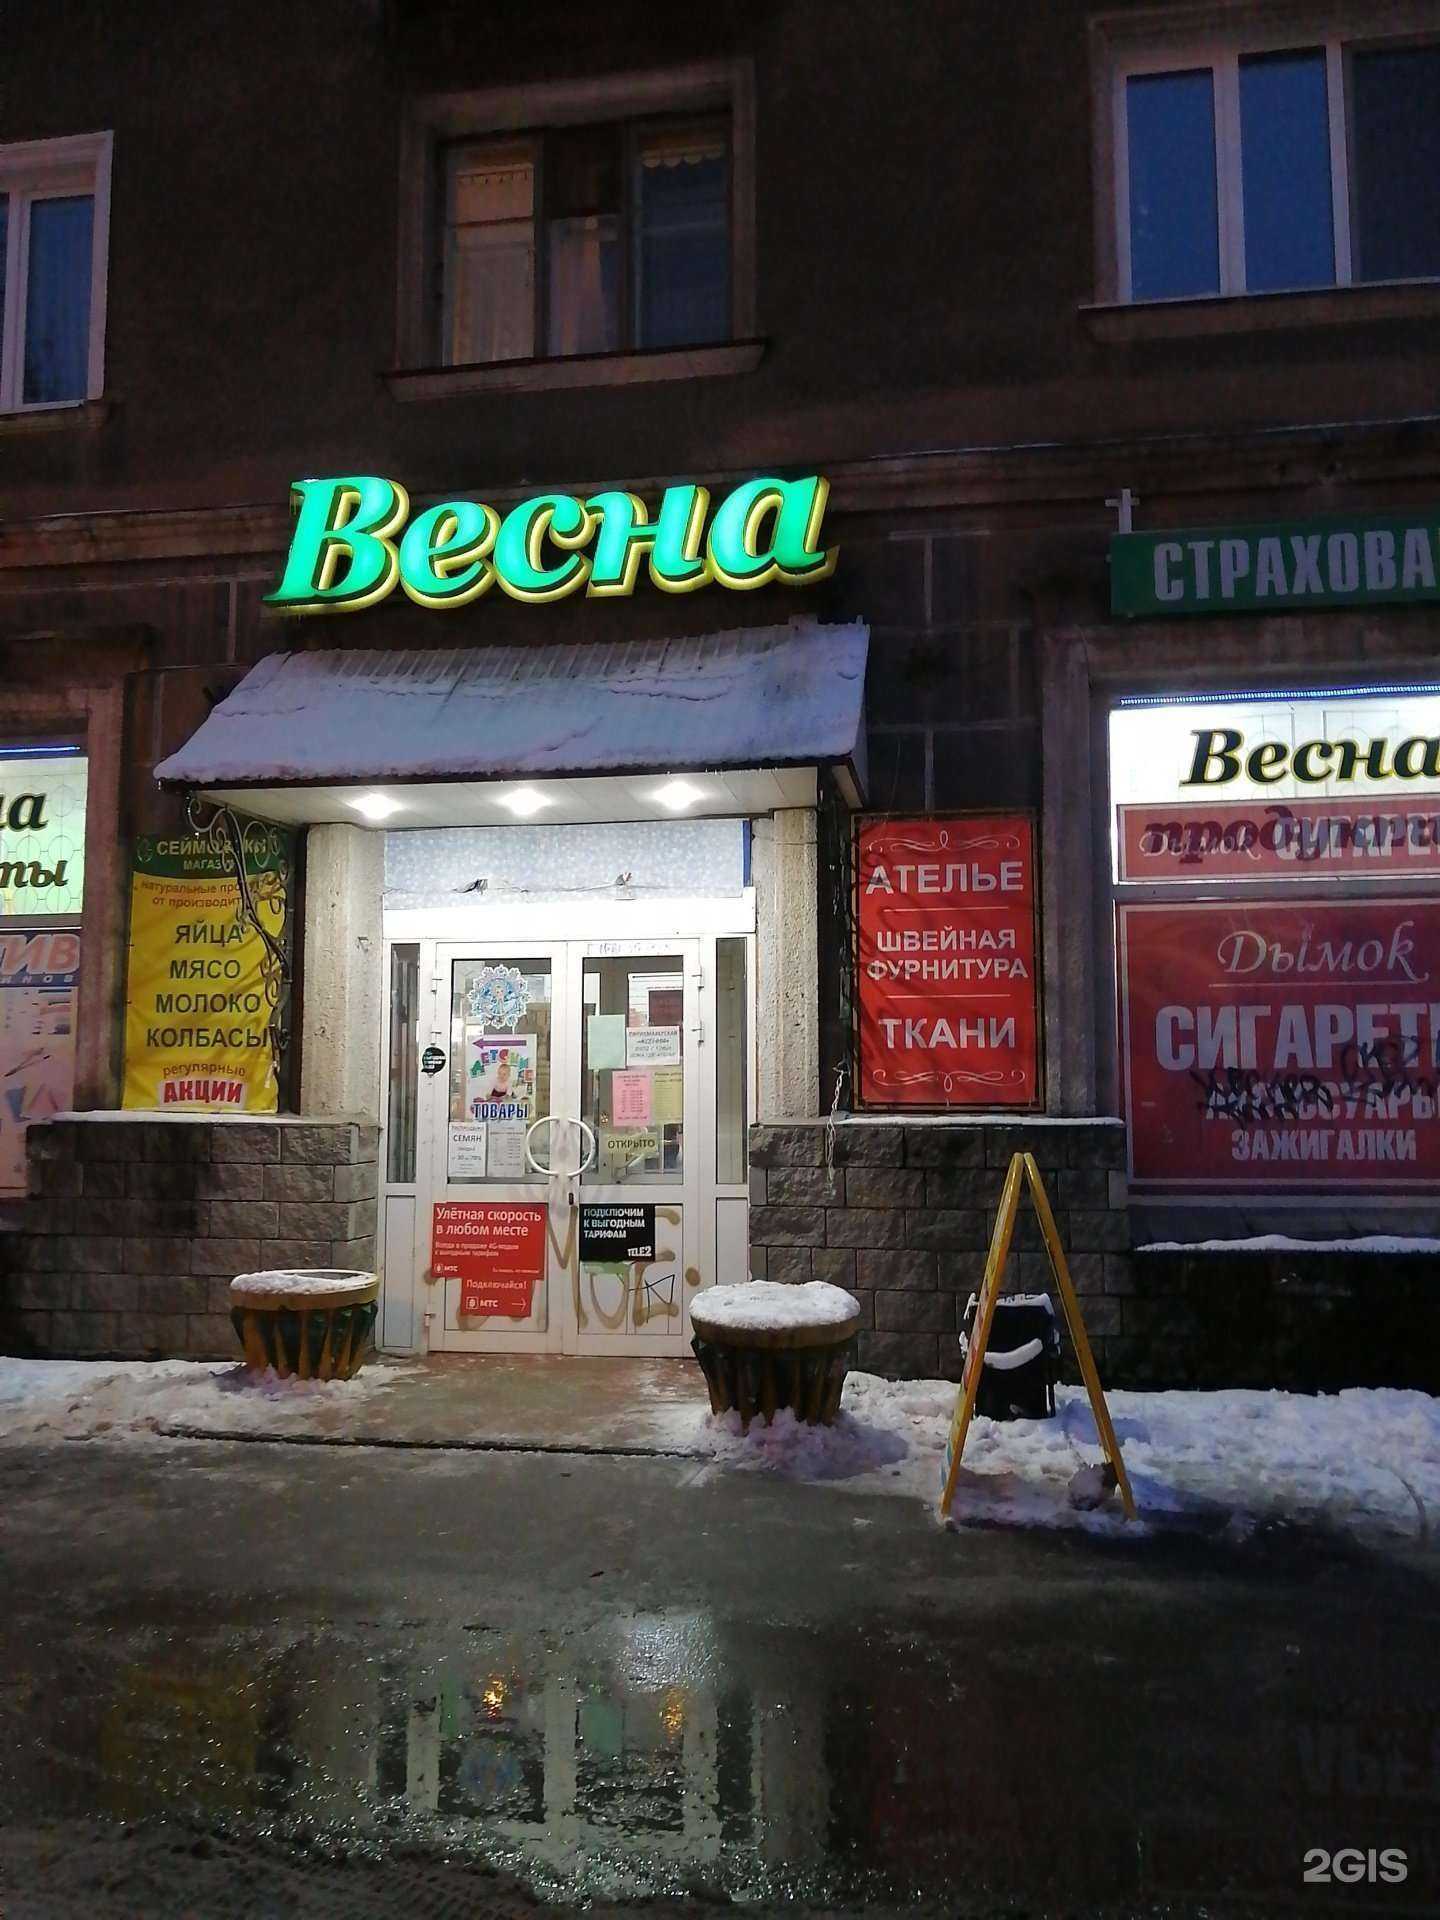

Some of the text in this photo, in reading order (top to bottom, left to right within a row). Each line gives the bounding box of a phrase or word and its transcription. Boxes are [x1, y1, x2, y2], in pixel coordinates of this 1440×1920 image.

[263, 474, 838, 612] Весна
[1154, 528, 1437, 601] СТРАХОВА
[1179, 729, 1440, 786] Весна
[0, 793, 48, 832] а
[865, 861, 1024, 895] АТЕЛЬЕ
[175, 920, 243, 947] ЯЙЦА
[877, 924, 1016, 952] ШВЕЙНАЯ
[1217, 921, 1430, 984] Дымок
[170, 959, 241, 979] МЯСО
[866, 957, 1029, 981] ФУРНИТУРА
[156, 993, 261, 1014] МОЛОКО
[147, 1027, 268, 1048] КОЛБАСЫ
[878, 1017, 1016, 1049] ТКАНИ
[163, 1080, 243, 1104] АКЦИИ
[474, 1102, 528, 1119] ТОВАРЫ
[608, 1139, 655, 1149] ОТКРЫТО
[1231, 1129, 1417, 1161] ЗАЖИГАЛКИ
[436, 1207, 541, 1223] Улётная скорость
[583, 1208, 644, 1218] ПОДКЛЮЧИМ
[591, 1219, 645, 1229] ВЫГОДНЫМ
[436, 1223, 529, 1236] в любом месте
[583, 1230, 627, 1238] ТАРИФАМ
[480, 1300, 498, 1308] МТС
